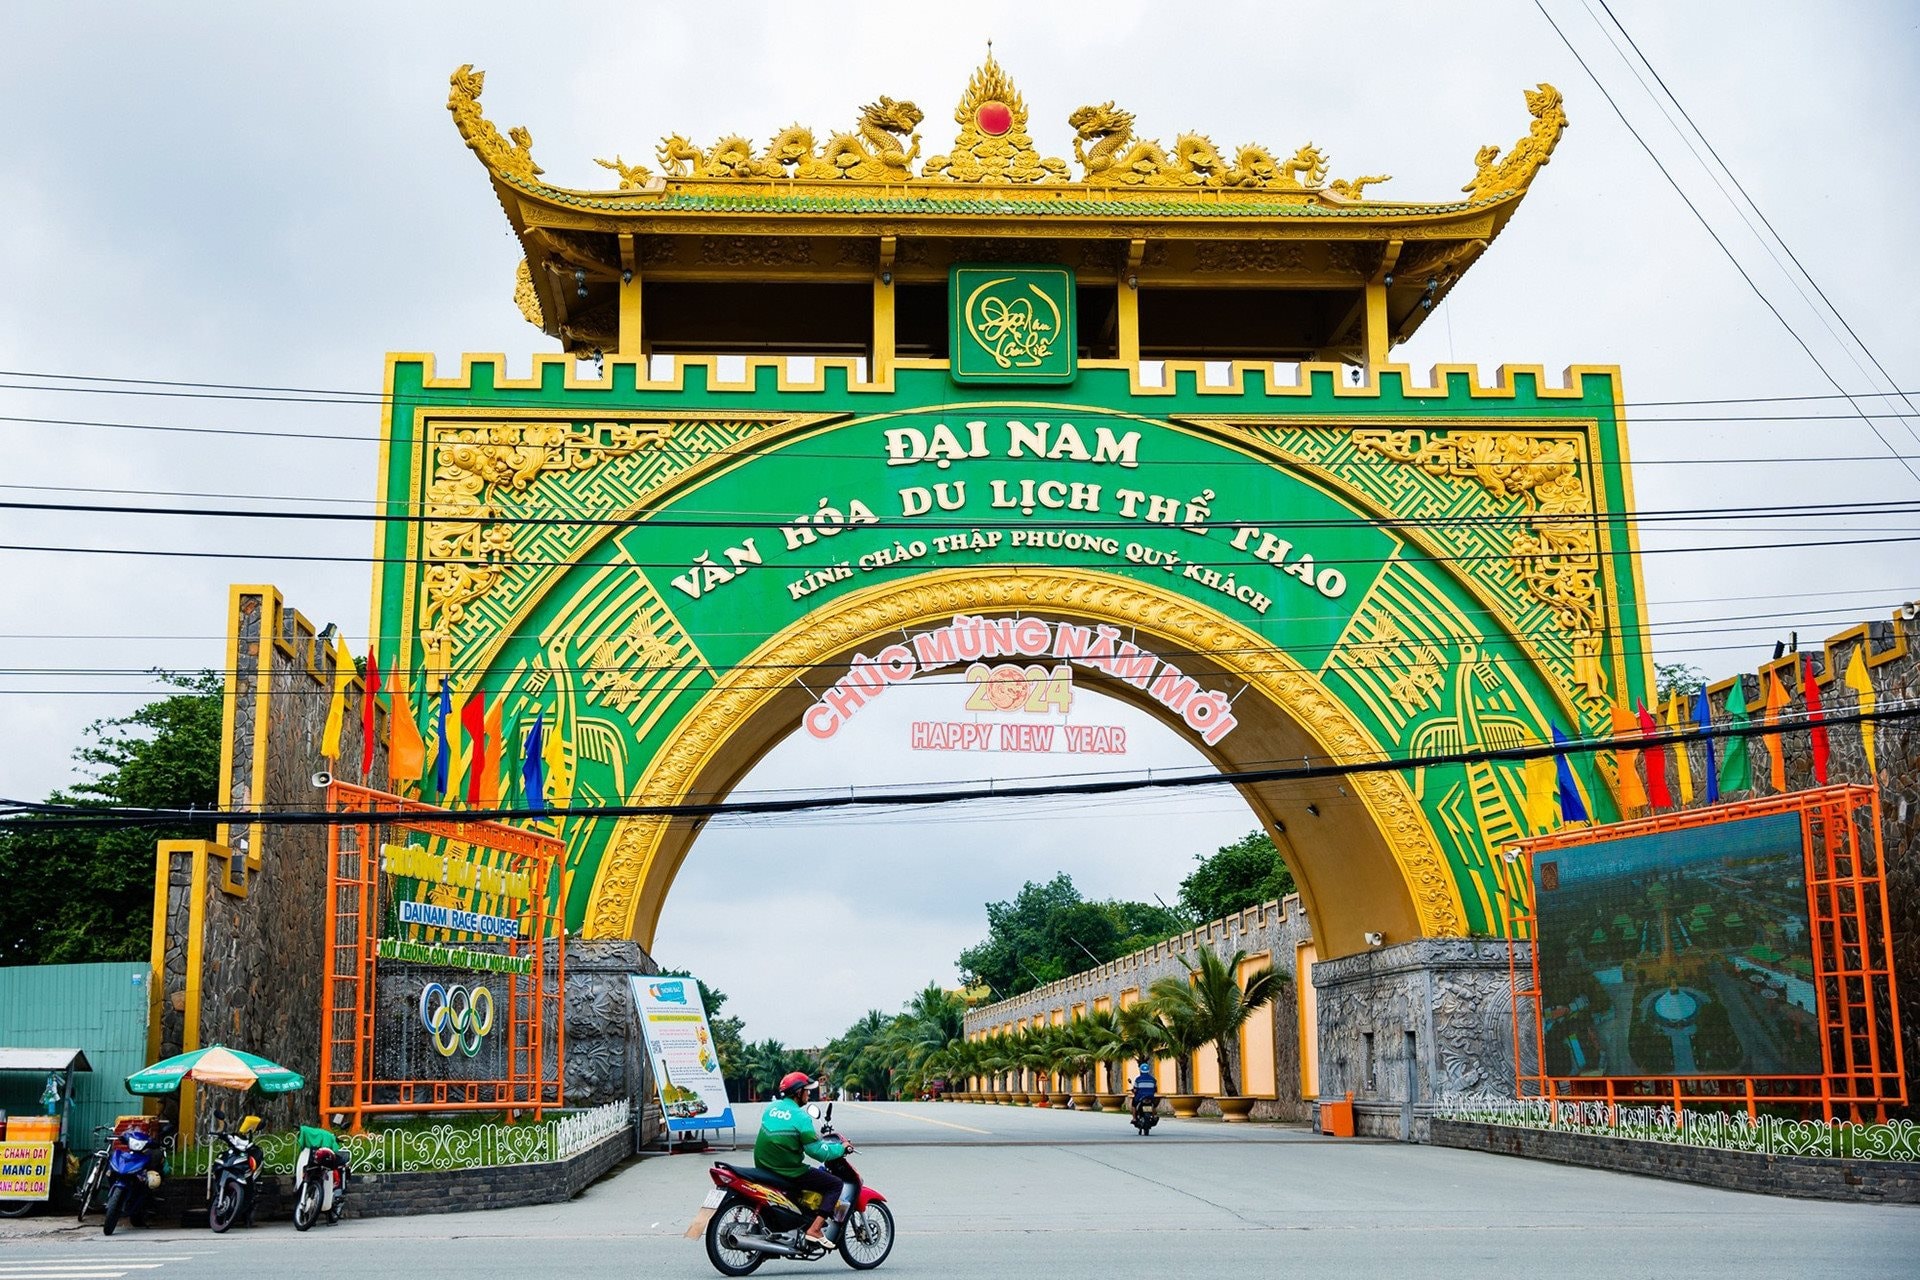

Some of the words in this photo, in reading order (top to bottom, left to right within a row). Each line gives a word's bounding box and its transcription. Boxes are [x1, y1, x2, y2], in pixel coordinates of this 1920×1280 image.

[884, 421, 990, 468] ĐẠI
[1006, 421, 1141, 468] NAM
[671, 549, 763, 599] VĂN
[779, 496, 880, 550] HÓA
[899, 480, 966, 516] DU
[990, 480, 1102, 515] LỊCH
[1116, 489, 1216, 535] THỂ
[1230, 520, 1347, 598] THAO
[787, 561, 854, 600] KÍNH
[859, 541, 927, 571] CHÀO
[933, 528, 1003, 553] THẬP
[1011, 530, 1119, 555] PHƯƠNG
[1125, 543, 1180, 571] QUÝ
[1183, 562, 1272, 614] KHÁCH
[804, 649, 917, 739] CHÚC
[917, 615, 1050, 671] MỪNG
[1055, 625, 1157, 686] NĂM
[1151, 665, 1238, 745] MỚI
[966, 663, 1072, 713] 2024
[913, 722, 992, 751] HAPPY
[1001, 725, 1055, 752] NEW
[1066, 726, 1126, 753] YEAR
[452, 911, 477, 932] RACE
[480, 916, 518, 938] COURSE
[769, 1108, 791, 1120] Grab
[2, 1165, 32, 1176] MANG
[36, 1165, 46, 1176] ĐI
